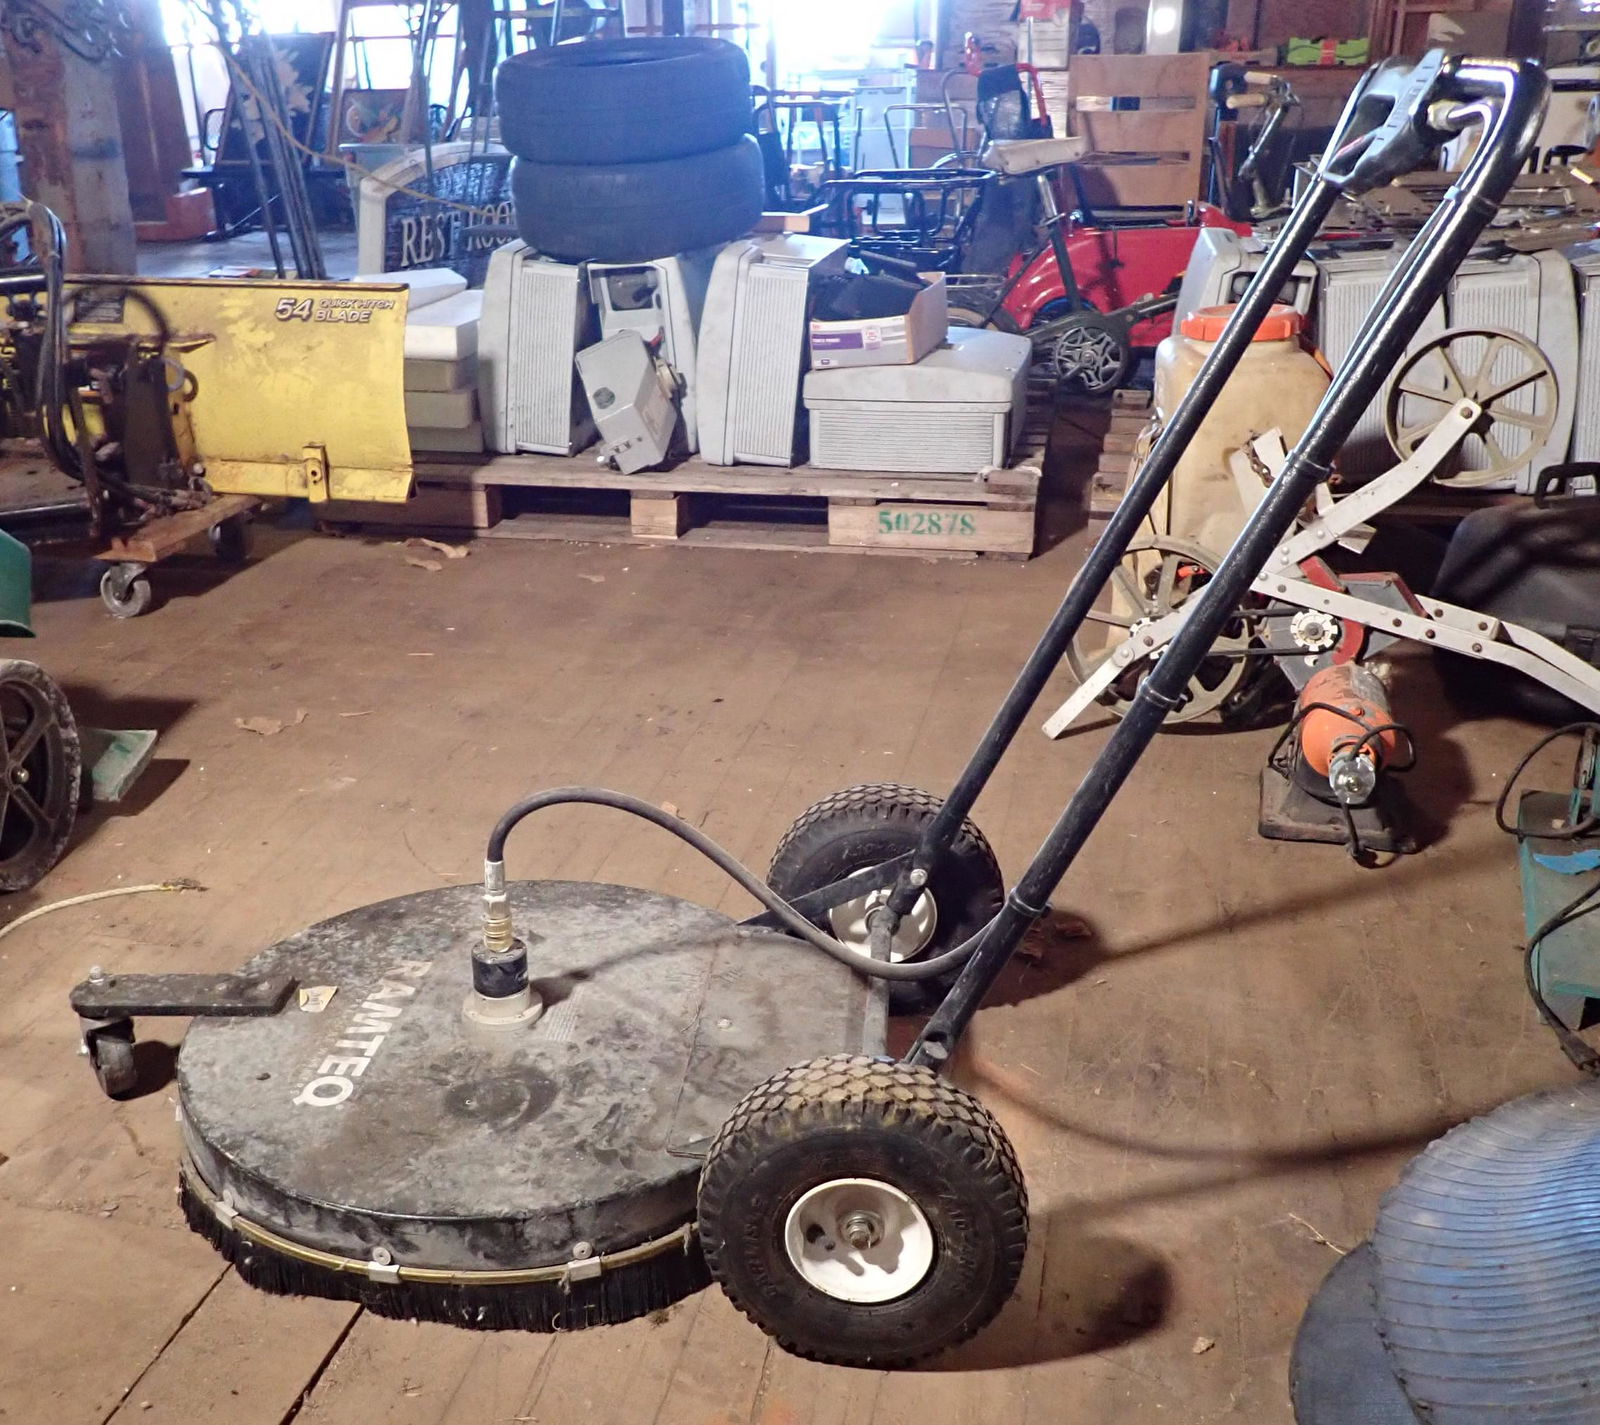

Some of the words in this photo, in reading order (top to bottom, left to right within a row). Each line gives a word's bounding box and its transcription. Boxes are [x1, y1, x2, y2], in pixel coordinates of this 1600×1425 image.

[400, 211, 461, 268] REST
[275, 297, 314, 322] 54
[314, 309, 372, 323] BLADE
[319, 298, 356, 310] QUICK
[357, 299, 396, 311] HITCH
[878, 509, 977, 536] 502878
[292, 960, 434, 1108] RAMTEQ
